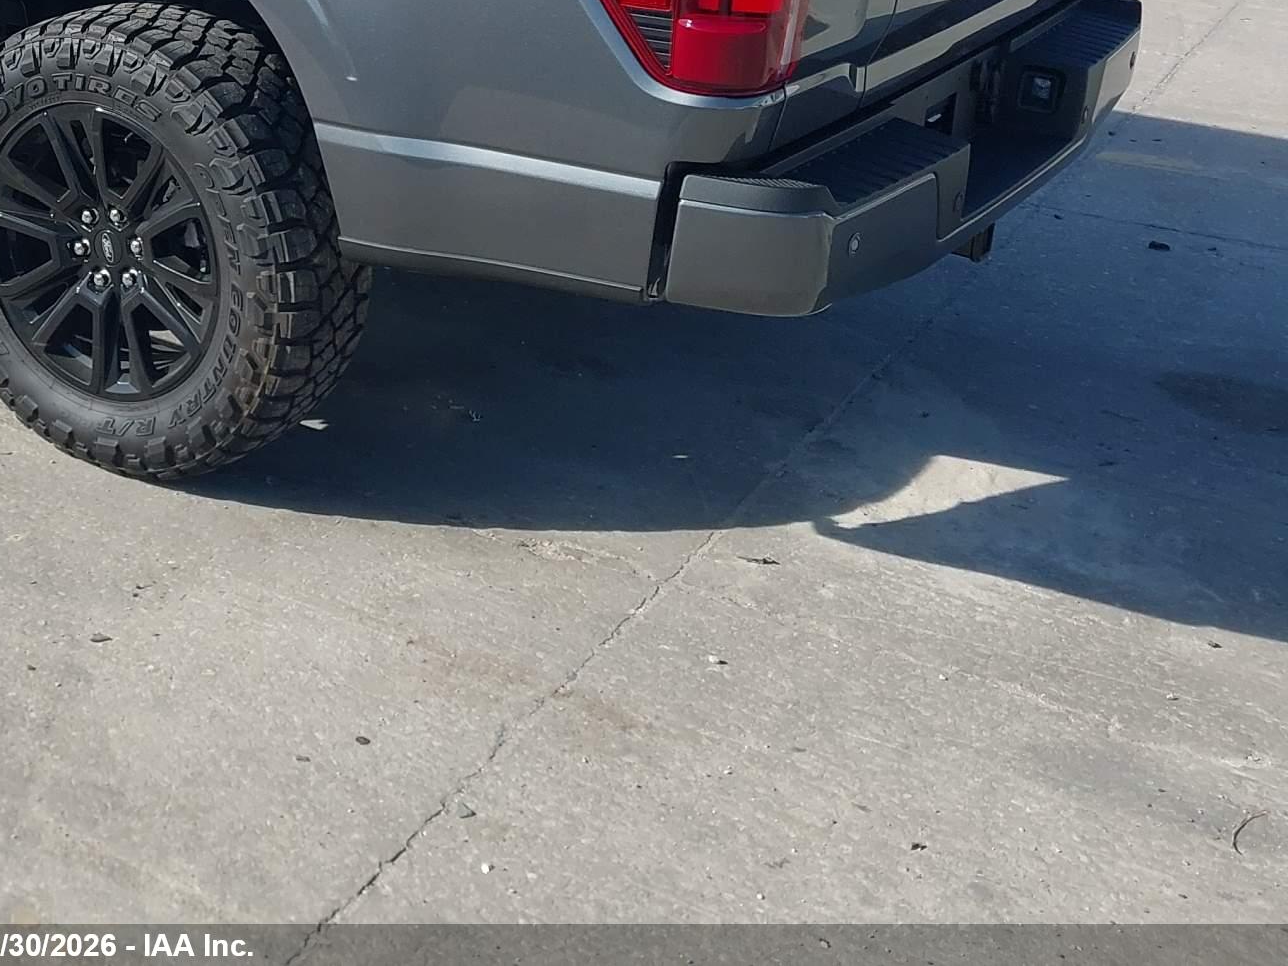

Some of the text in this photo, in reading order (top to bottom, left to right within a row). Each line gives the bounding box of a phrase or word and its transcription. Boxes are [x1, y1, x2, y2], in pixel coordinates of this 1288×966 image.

[52, 72, 163, 122] TIRES
[96, 161, 245, 436] OPEN COUNTRY R/T
